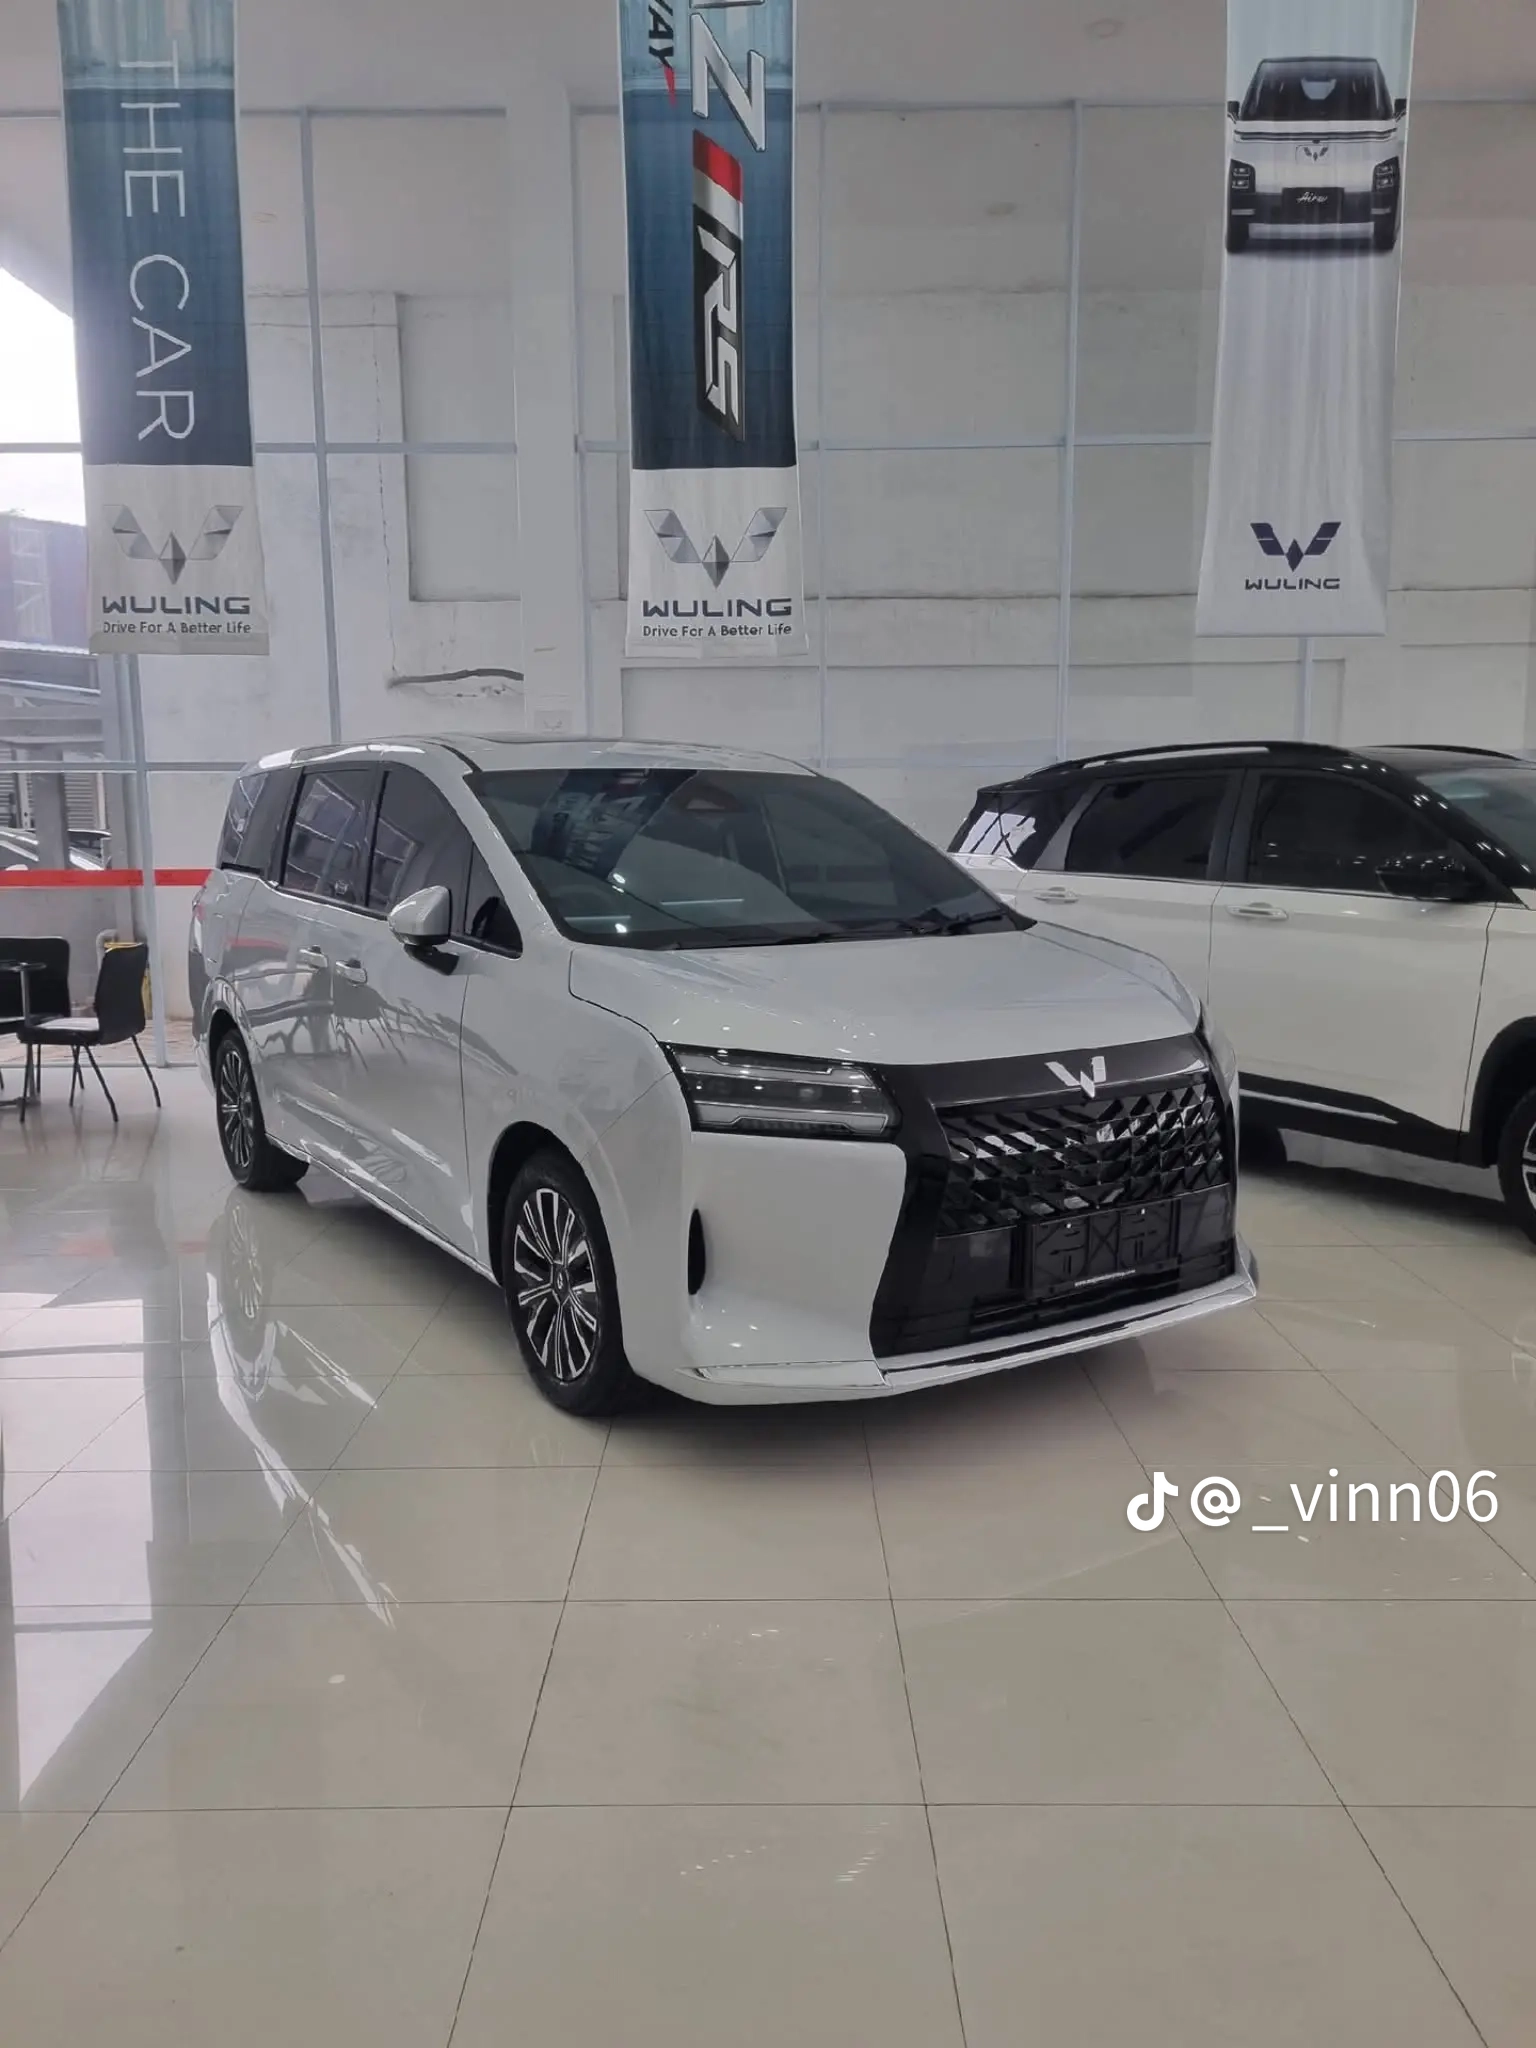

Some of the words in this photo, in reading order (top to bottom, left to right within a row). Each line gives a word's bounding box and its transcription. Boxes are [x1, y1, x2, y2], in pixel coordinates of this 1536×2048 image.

[119, 40, 186, 217] THE
[697, 224, 739, 427] RS
[129, 254, 196, 441] CAR
[1244, 578, 1340, 590] WULING
[102, 596, 251, 615] WULING
[643, 598, 792, 617] WULING
[103, 621, 137, 634] Drive
[140, 621, 163, 634] For
[166, 622, 177, 634] A
[180, 621, 222, 634] Better
[226, 621, 252, 634] Life
[643, 625, 678, 637] Drive
[682, 625, 704, 637] For
[707, 625, 717, 637] A
[720, 625, 763, 637] Better
[767, 623, 792, 636] Life
